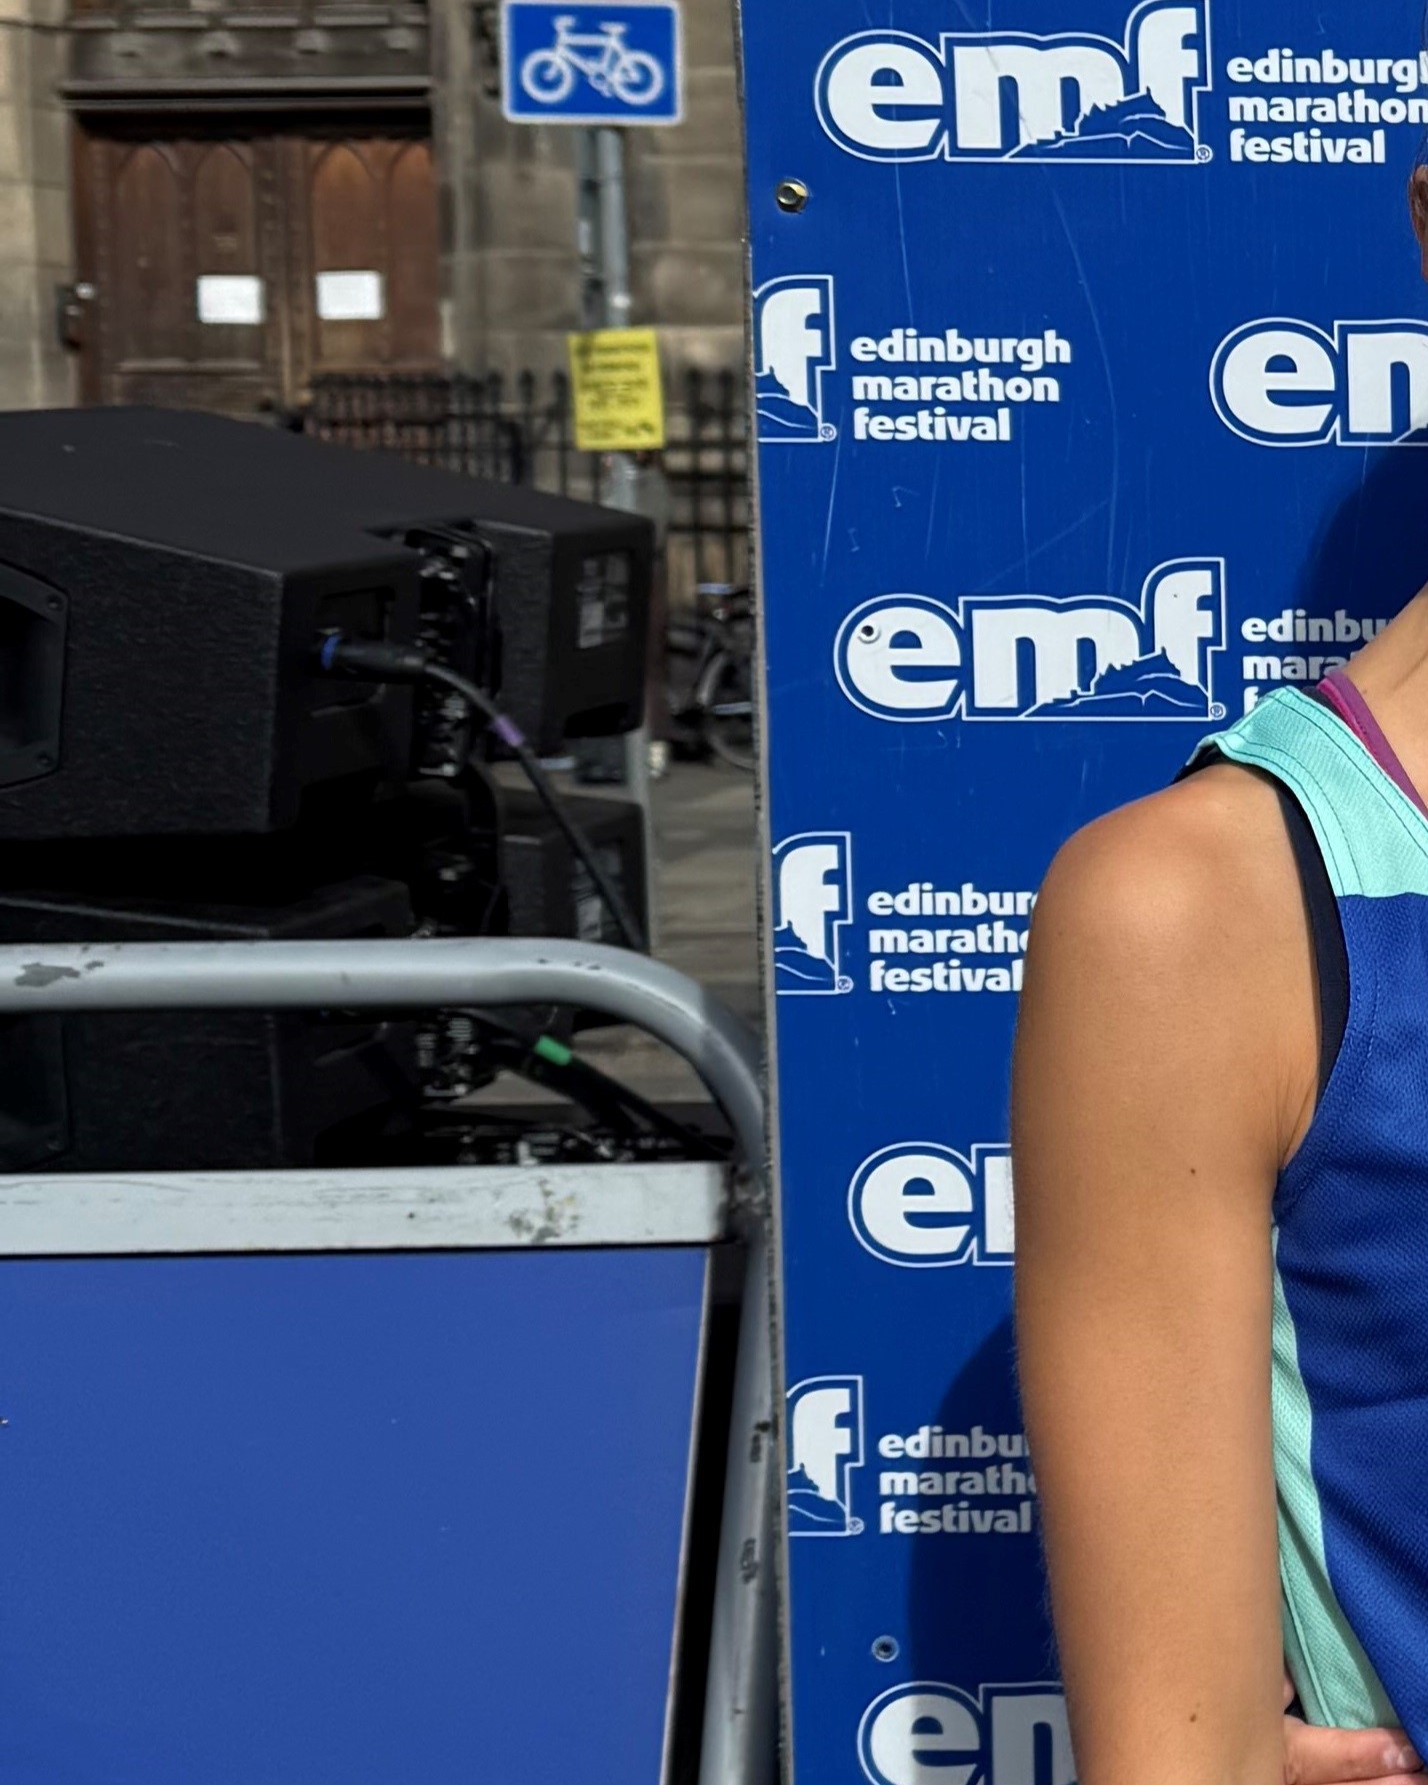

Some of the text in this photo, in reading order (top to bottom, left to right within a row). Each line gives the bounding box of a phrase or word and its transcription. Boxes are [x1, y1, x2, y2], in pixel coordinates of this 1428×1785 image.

[821, 1, 1206, 157] emf
[1229, 127, 1386, 164] festival
[850, 328, 1072, 372] edinburgh
[852, 367, 1060, 402] marathon
[853, 406, 1011, 441] festival
[841, 564, 1219, 715] emf
